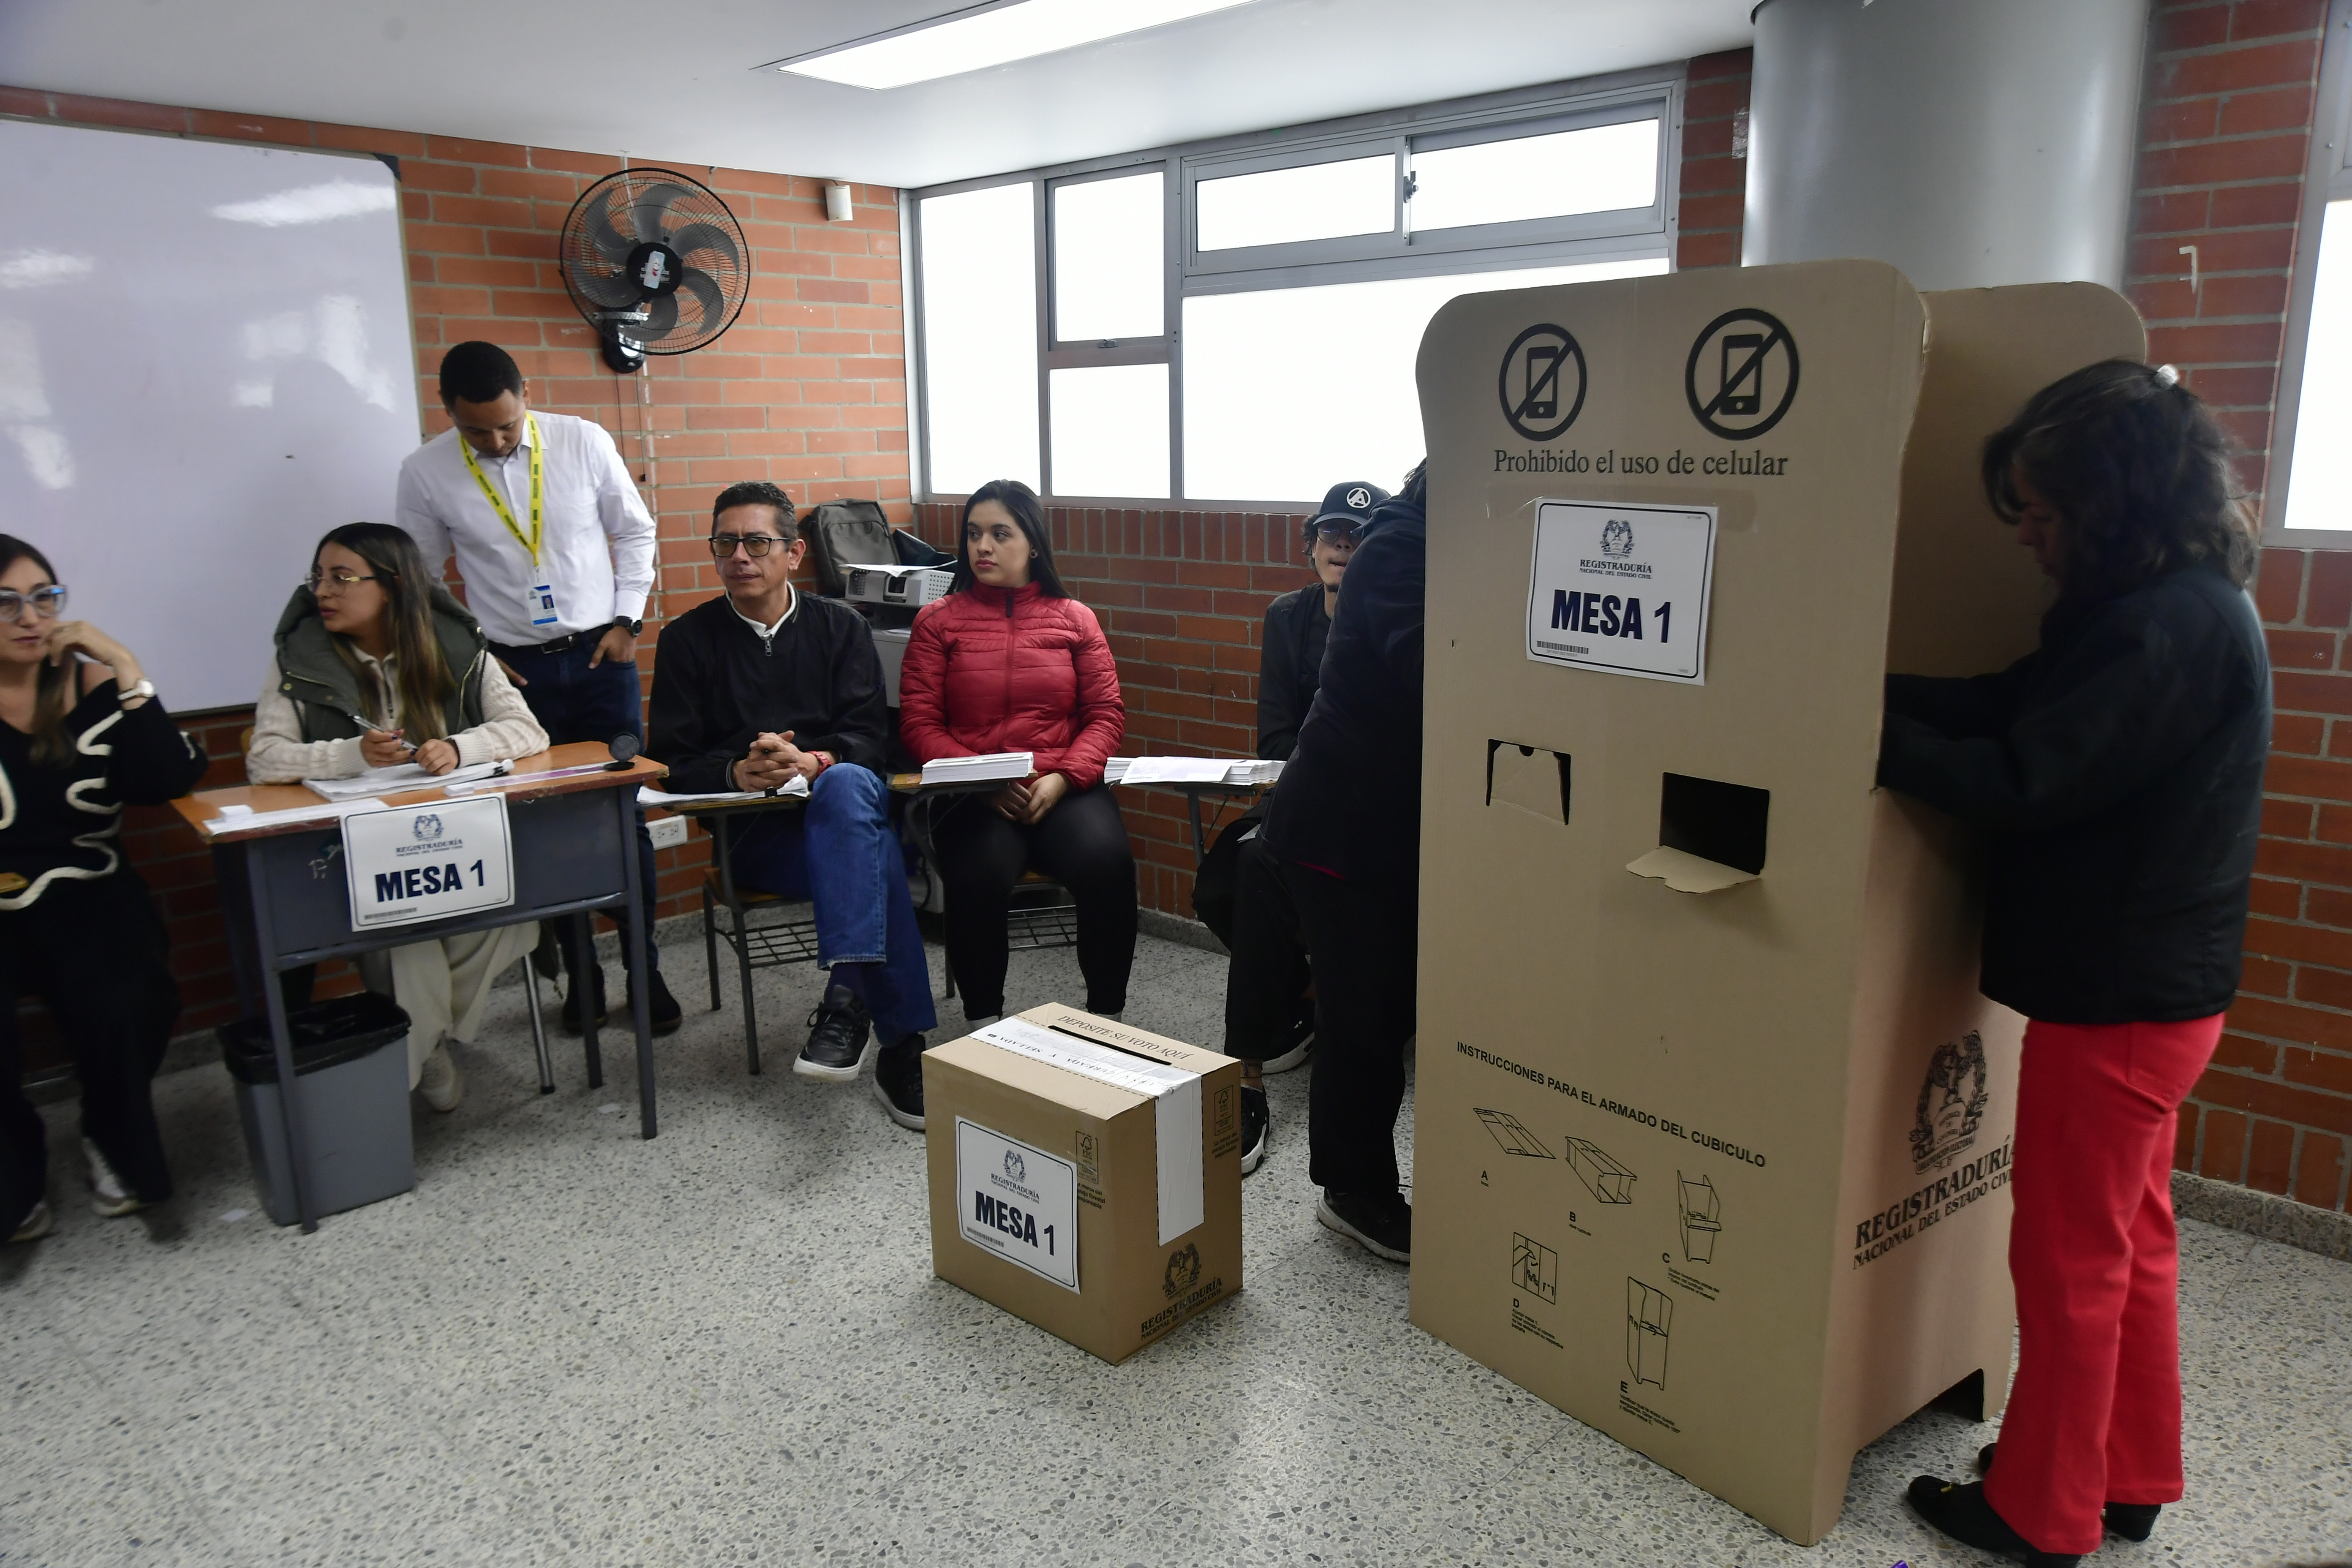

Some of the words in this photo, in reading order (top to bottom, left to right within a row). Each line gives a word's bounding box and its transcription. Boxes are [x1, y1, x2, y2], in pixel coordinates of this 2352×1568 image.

[1494, 450, 1589, 474] Prohibido
[1596, 450, 1614, 474] el
[1621, 457, 1659, 474] uso
[1666, 450, 1695, 475] de
[1702, 450, 1788, 476] celular
[1580, 559, 1652, 573] REGISTRADURÍA
[1551, 589, 1643, 640] MESA
[1654, 601, 1671, 643] 1
[396, 838, 463, 853] REGISTRADURÍA
[375, 863, 463, 902] MESA
[469, 859, 484, 887] 1
[1000, 1037, 1043, 1053] SELLADA
[1057, 1016, 1113, 1036] DEPOSITE
[1109, 1031, 1130, 1040] SU
[1127, 1037, 1160, 1050] VOTO
[1156, 1048, 1194, 1059] AQUÍ
[1456, 1041, 1544, 1086] INSTRUCCIONES
[1548, 1077, 1579, 1100] PARA
[1581, 1091, 1596, 1107] EL
[1599, 1098, 1658, 1128] ARMADO
[1661, 1119, 1688, 1140] DEL
[1691, 1130, 1765, 1168] CUBICULO
[1481, 1170, 1488, 1181] A
[991, 1173, 1040, 1200] REGISTRADURÍA
[1016, 1191, 1030, 1200] ESTADO
[1089, 1192, 1105, 1204] forestal
[975, 1190, 1038, 1249] MESA
[1044, 1224, 1054, 1257] 1
[1569, 1211, 1576, 1222] B
[1852, 1224, 1914, 1270] NACIONAL
[1917, 1208, 1941, 1233] DEL
[1944, 1181, 1988, 1217] ESTADO
[1990, 1168, 2013, 1190] CIVI
[1662, 1252, 1670, 1263] C
[1141, 1277, 1222, 1333] REGISTRADURÍA
[1513, 1298, 1519, 1308] D
[1141, 1320, 1171, 1340] NACIONAL
[1208, 1289, 1222, 1300] CIVIL
[1620, 1380, 1628, 1394] E
